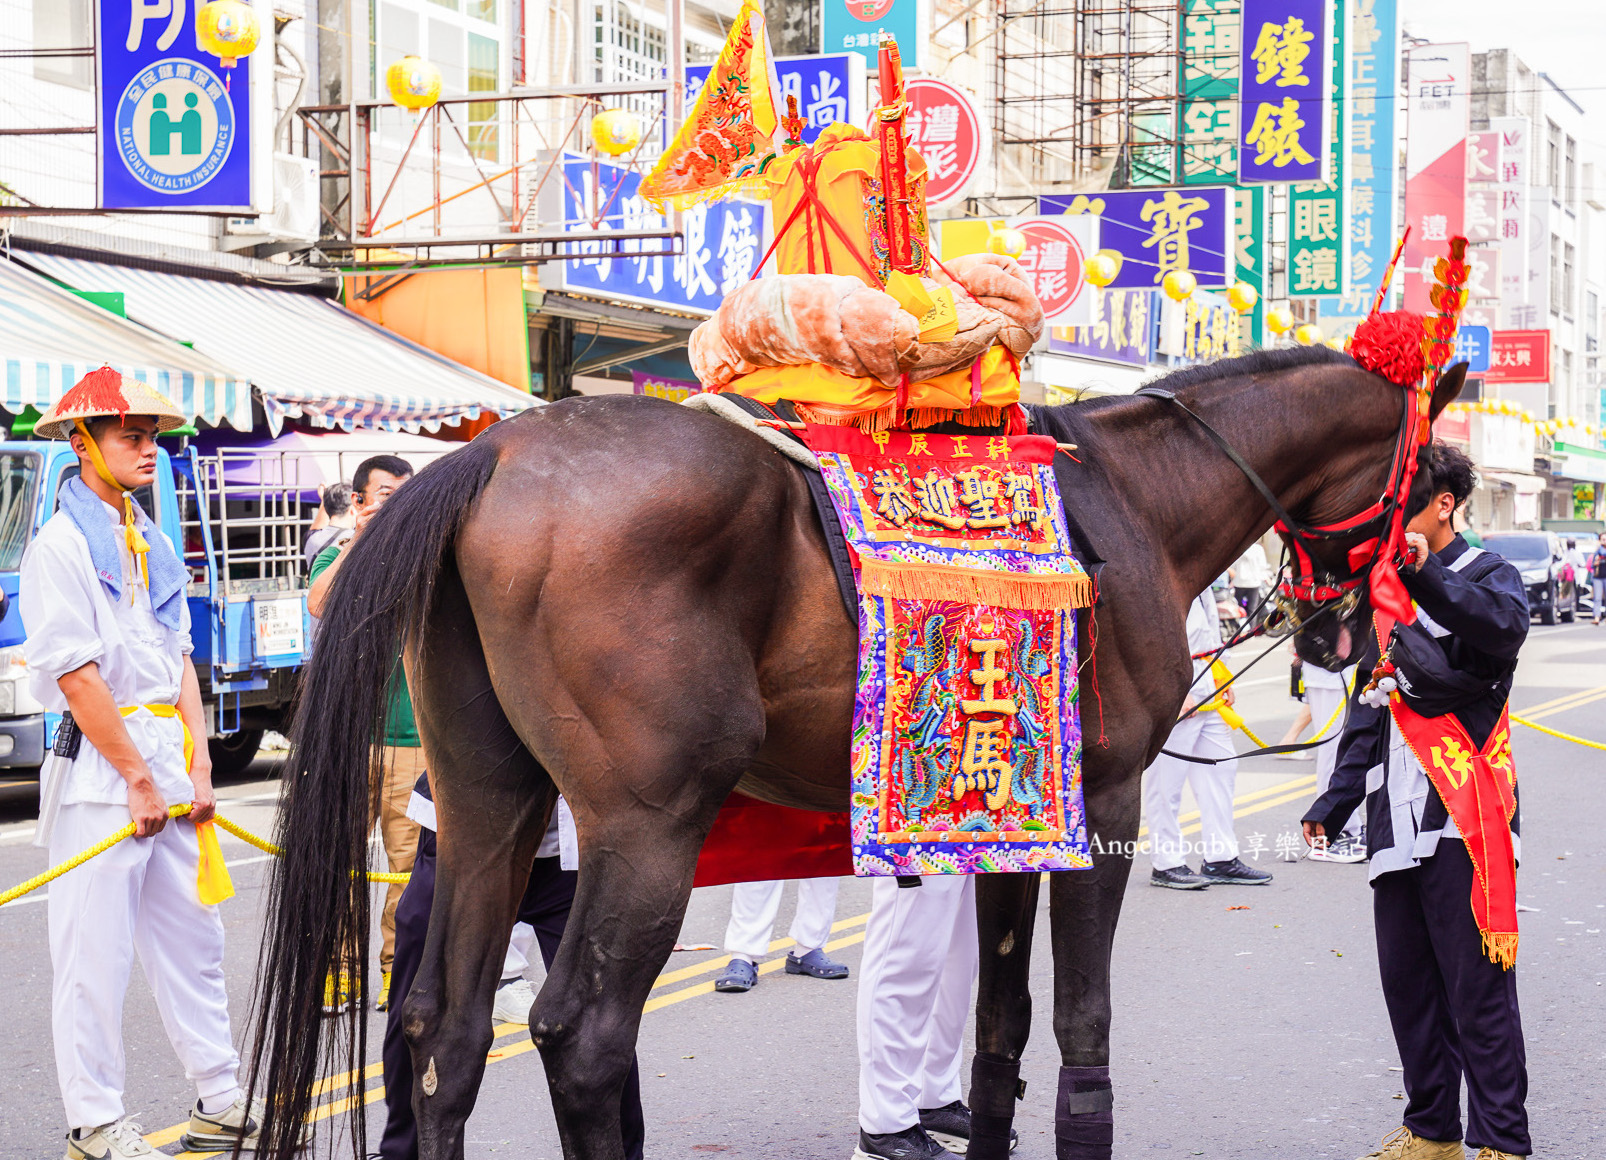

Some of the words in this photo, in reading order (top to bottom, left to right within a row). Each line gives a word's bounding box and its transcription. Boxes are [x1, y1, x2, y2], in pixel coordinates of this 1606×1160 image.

[128, 64, 223, 103] 全民健康保險
[1245, 16, 1315, 167] 鐘錶
[1420, 85, 1455, 98] FET
[122, 127, 150, 180] NATIONAL
[151, 174, 192, 189] HEALTH
[192, 124, 229, 184] INSURANCE
[1294, 184, 1339, 291] 眼鏡
[872, 431, 1012, 461] 甲辰正科
[872, 470, 1042, 531] 恭迎聖駕
[951, 638, 1017, 811] 王馬
